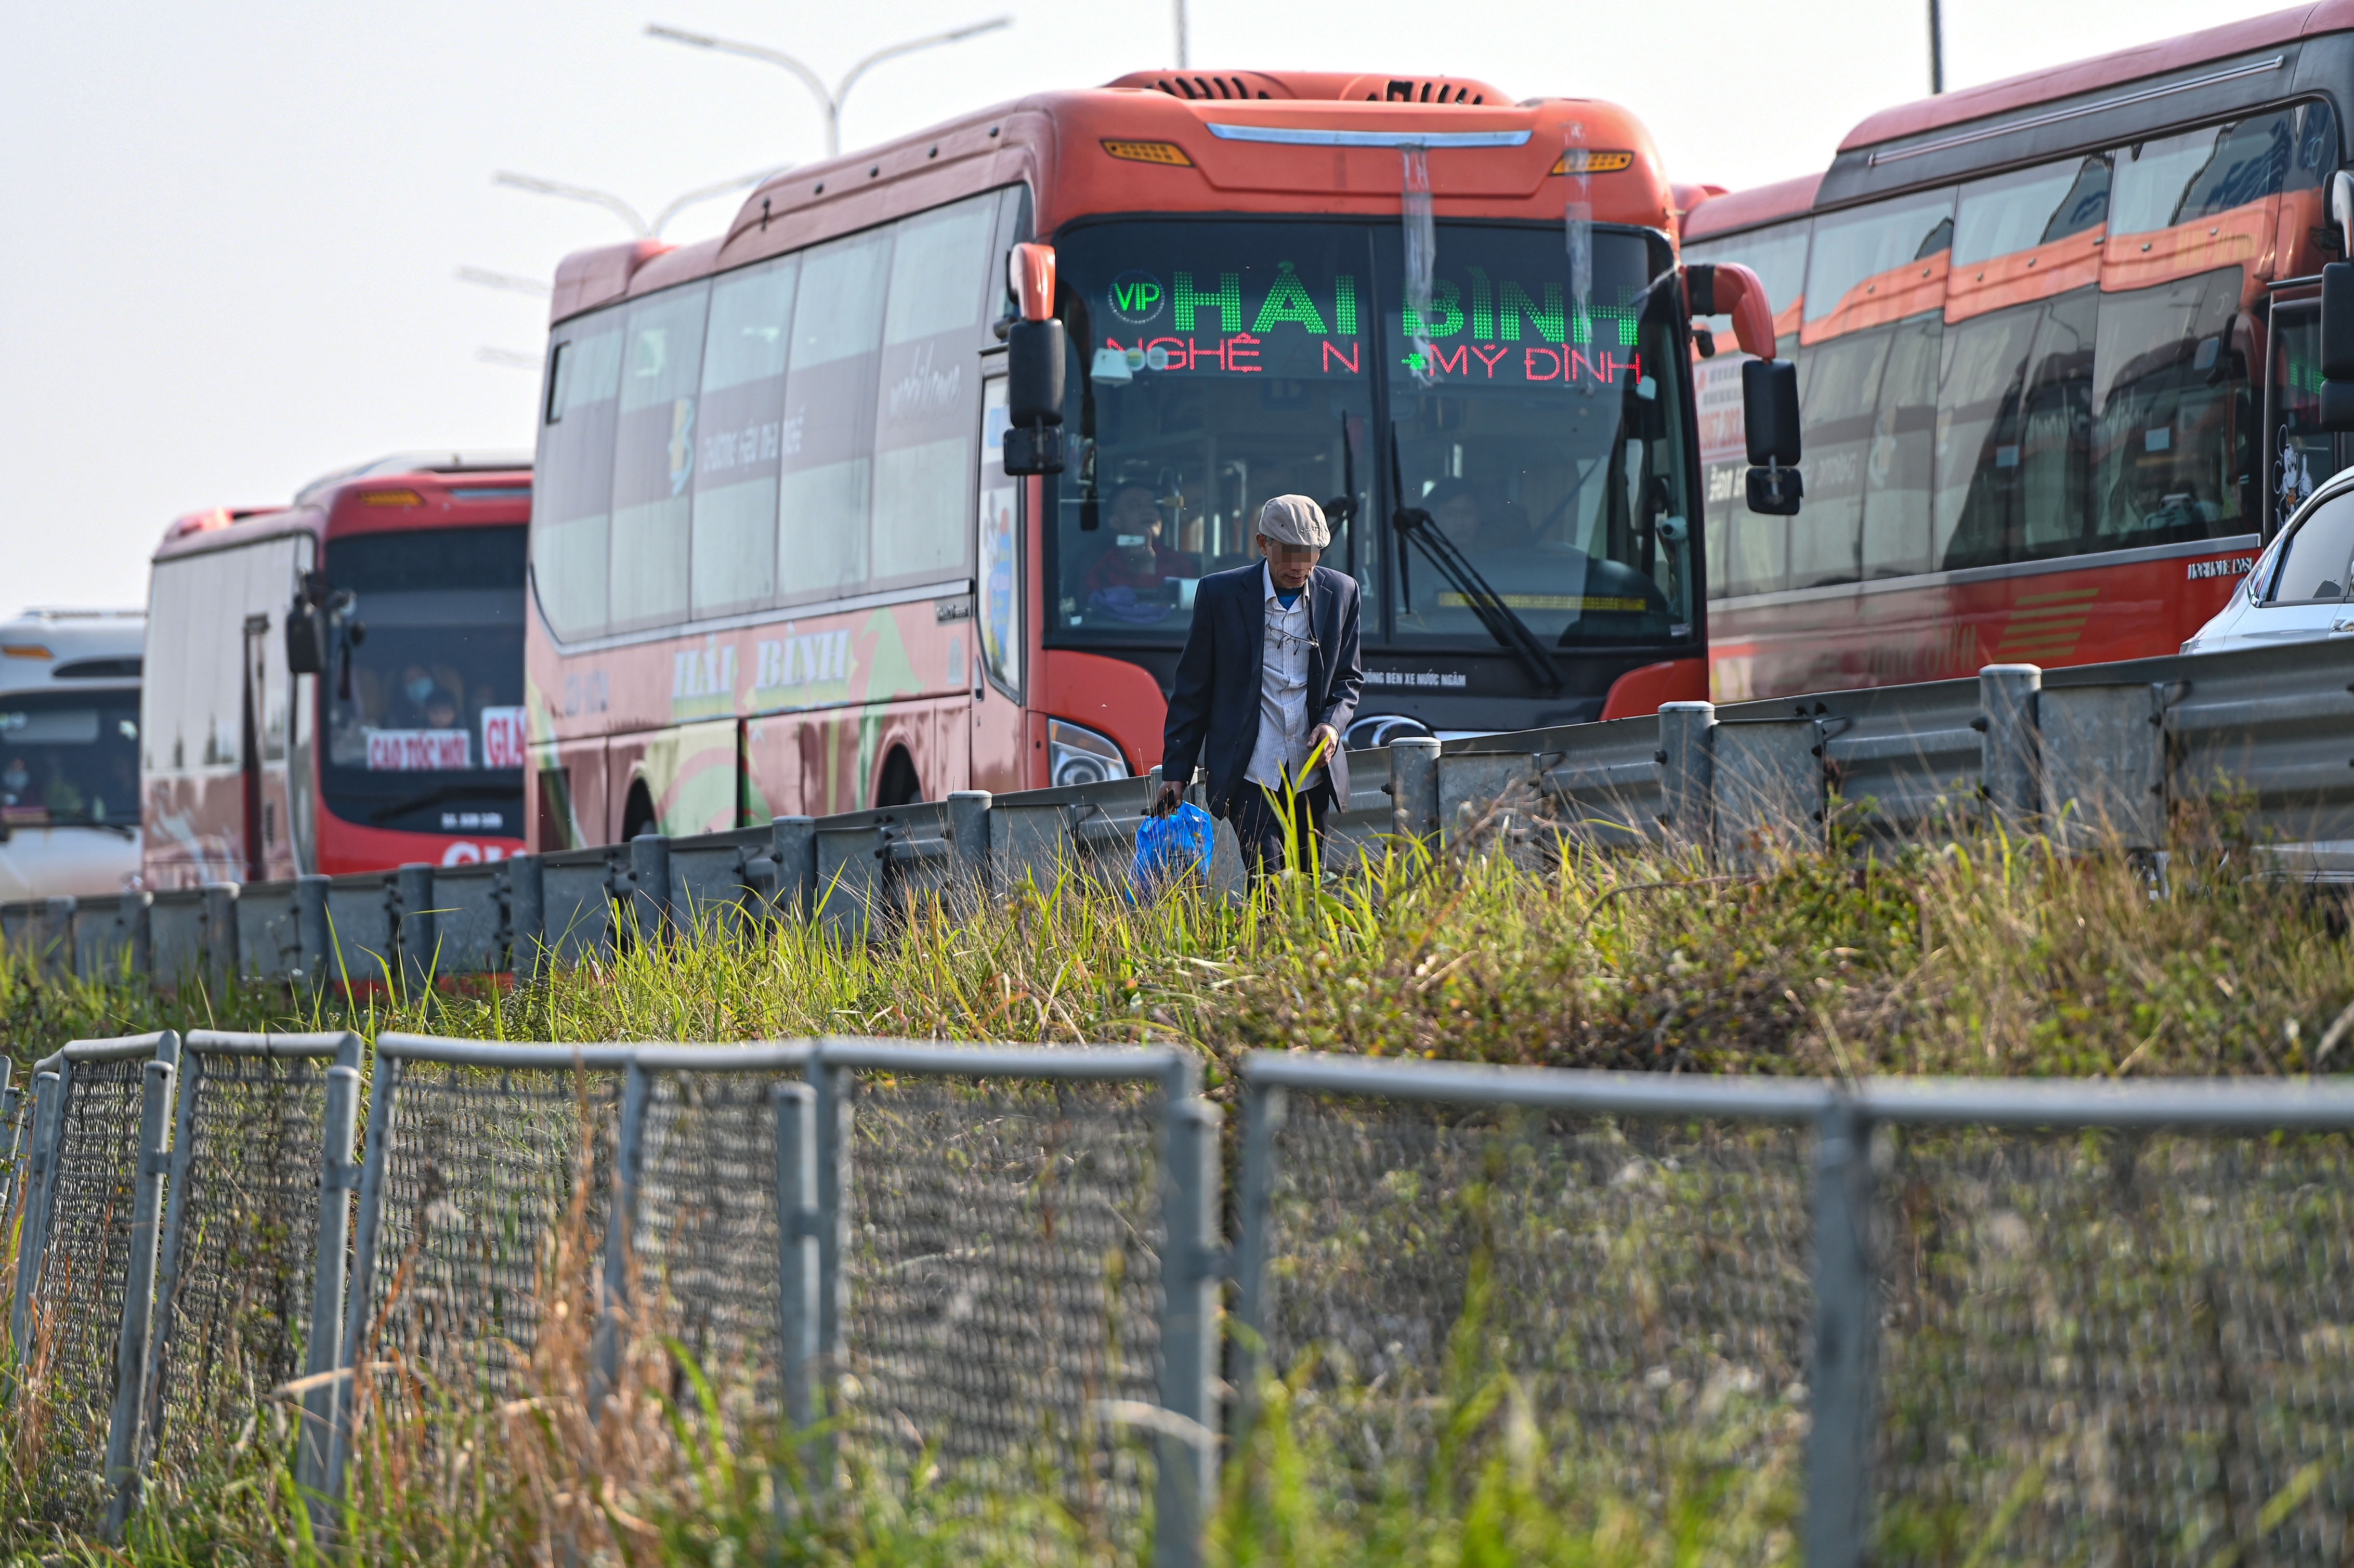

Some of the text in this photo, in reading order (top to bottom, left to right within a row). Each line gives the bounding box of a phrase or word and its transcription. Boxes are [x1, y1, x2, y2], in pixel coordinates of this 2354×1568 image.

[1114, 283, 1160, 311] VIP
[1173, 261, 1638, 346] HẢI BÌNH
[1429, 343, 1641, 385] MỸ ĐÌNH
[754, 620, 851, 689] BÌNH
[1404, 673, 1416, 685] XE
[371, 737, 403, 770] CAO
